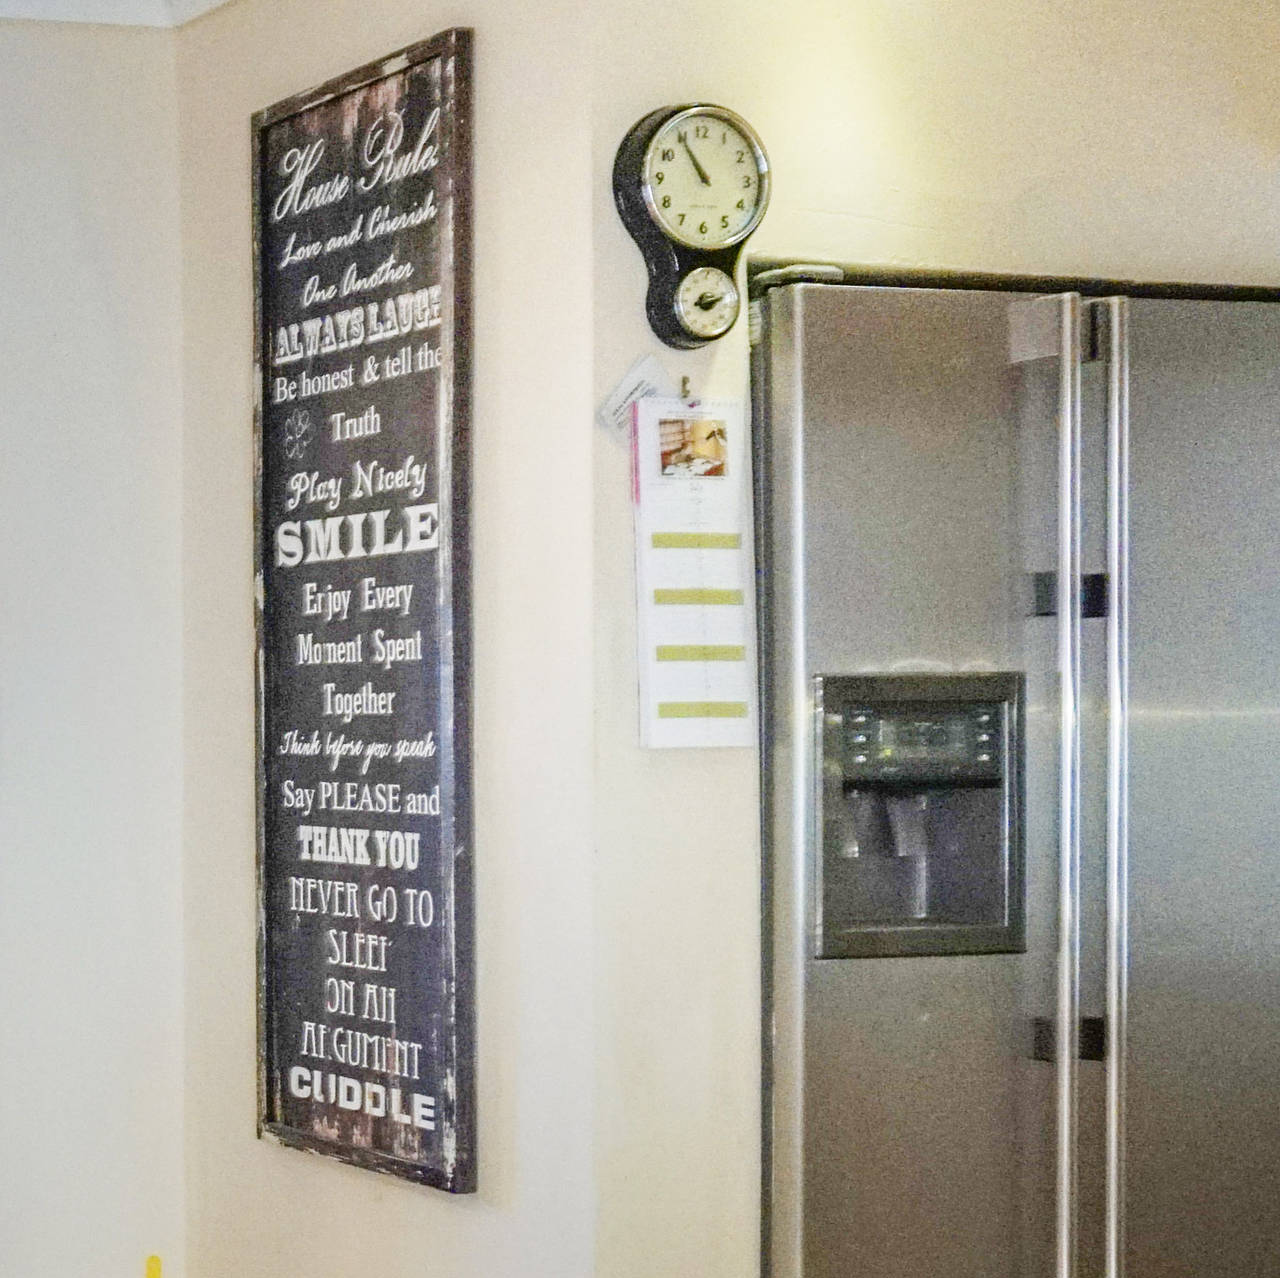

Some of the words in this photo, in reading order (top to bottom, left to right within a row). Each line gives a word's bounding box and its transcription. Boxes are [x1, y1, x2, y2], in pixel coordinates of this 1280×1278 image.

[662, 149, 675, 162] 10
[695, 126, 710, 139] 12
[274, 139, 350, 220] House
[279, 232, 323, 269] Love
[326, 213, 364, 252] and
[368, 190, 438, 240] Cherish
[303, 274, 338, 306] One
[341, 253, 415, 297] Another
[275, 306, 365, 365] ALWAYS
[275, 376, 297, 402] Be
[301, 364, 354, 397] honest
[364, 355, 381, 384] &
[385, 346, 413, 378] tell
[417, 342, 441, 371] the
[331, 405, 382, 442] Truth
[288, 472, 342, 511] Play
[352, 455, 427, 499] Nicely
[275, 503, 440, 568] SMILE
[361, 577, 414, 615] Every
[297, 633, 362, 665] Moment
[374, 629, 422, 669] Spent
[323, 682, 396, 723] Together
[280, 729, 321, 755] Think
[326, 731, 364, 771] before
[361, 742, 392, 775] you
[394, 731, 437, 763] speak
[283, 780, 316, 816] Say
[319, 781, 401, 813] PLEASE
[406, 786, 440, 816] and
[299, 825, 371, 865] THANK
[375, 830, 420, 870] YOU
[290, 876, 360, 918] NEVER
[368, 884, 398, 923] GO
[404, 888, 434, 927] TO
[326, 977, 355, 1016] ON
[290, 1065, 436, 1131] CUDDLE
